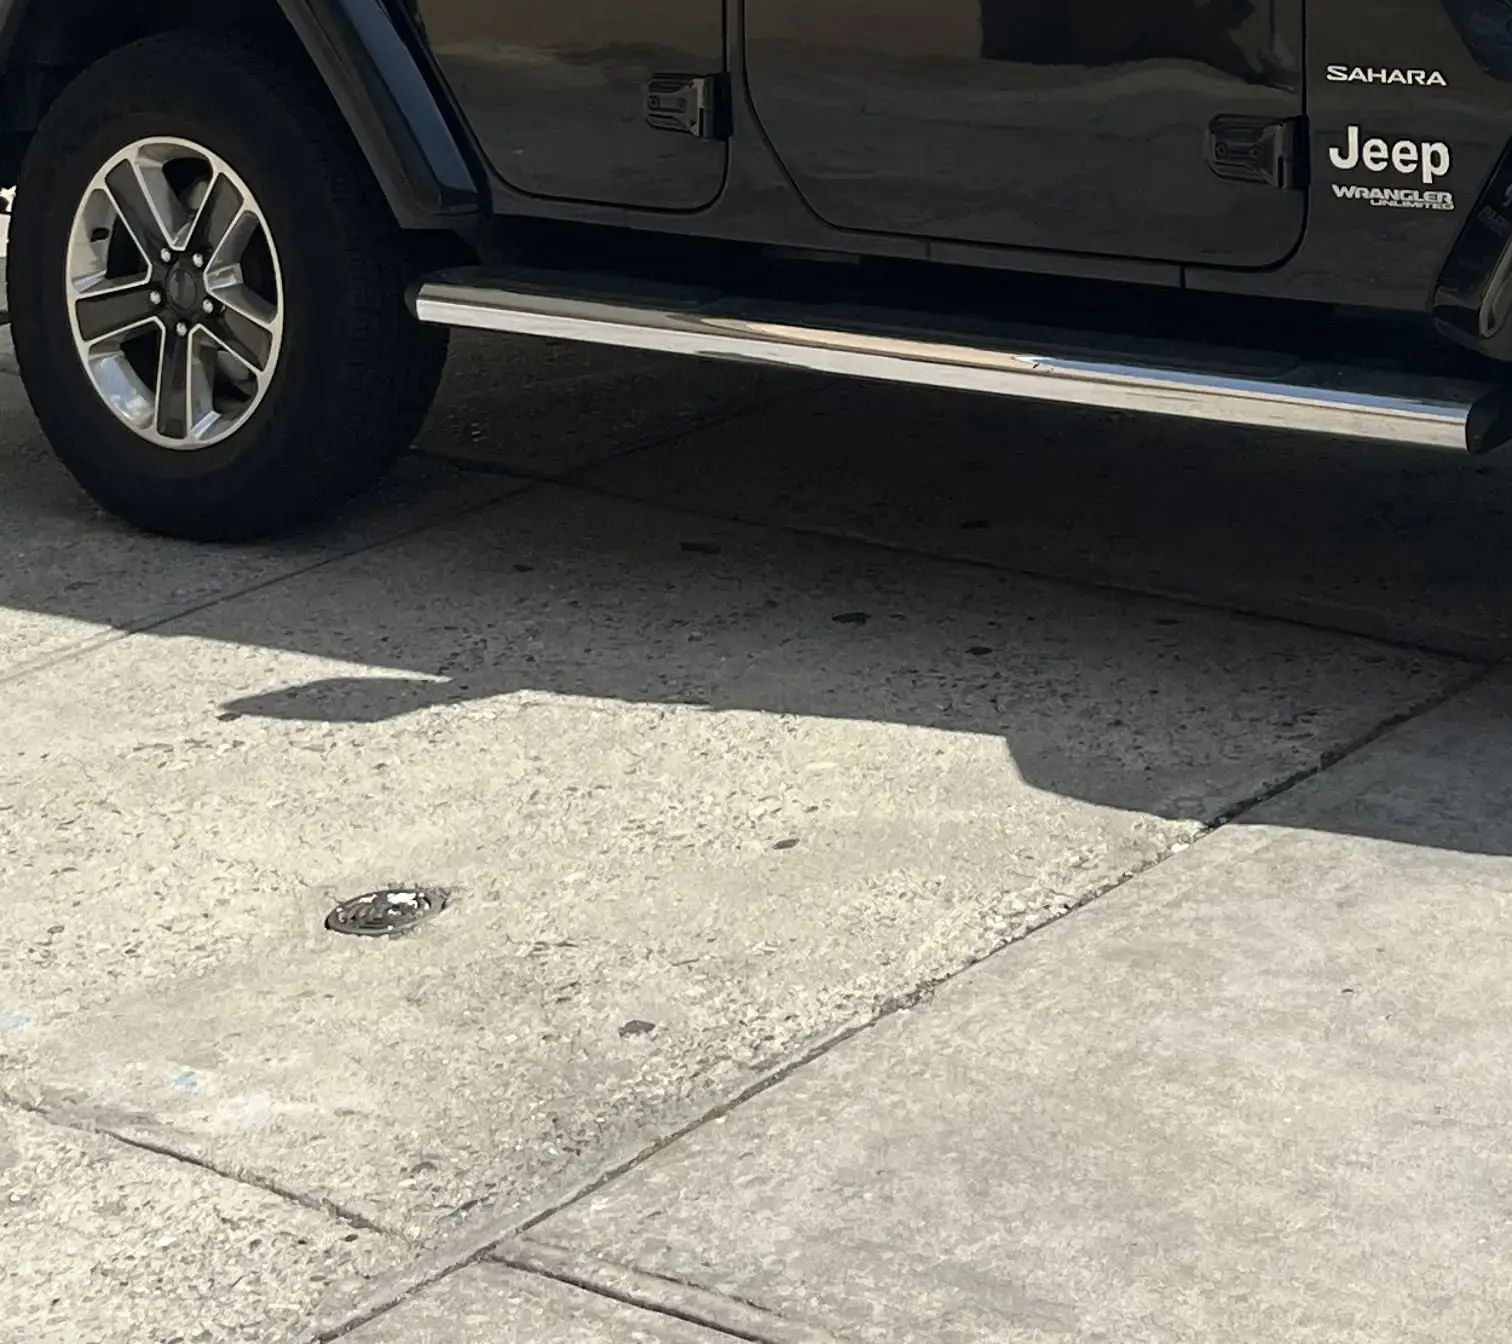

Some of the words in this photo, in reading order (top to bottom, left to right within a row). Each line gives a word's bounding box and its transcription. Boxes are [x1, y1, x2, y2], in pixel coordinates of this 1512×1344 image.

[1326, 65, 1448, 87] SAHARA
[1328, 125, 1450, 184] Jeep
[1331, 184, 1453, 204] WRANGLER
[1369, 198, 1455, 211] UNLIMITED
